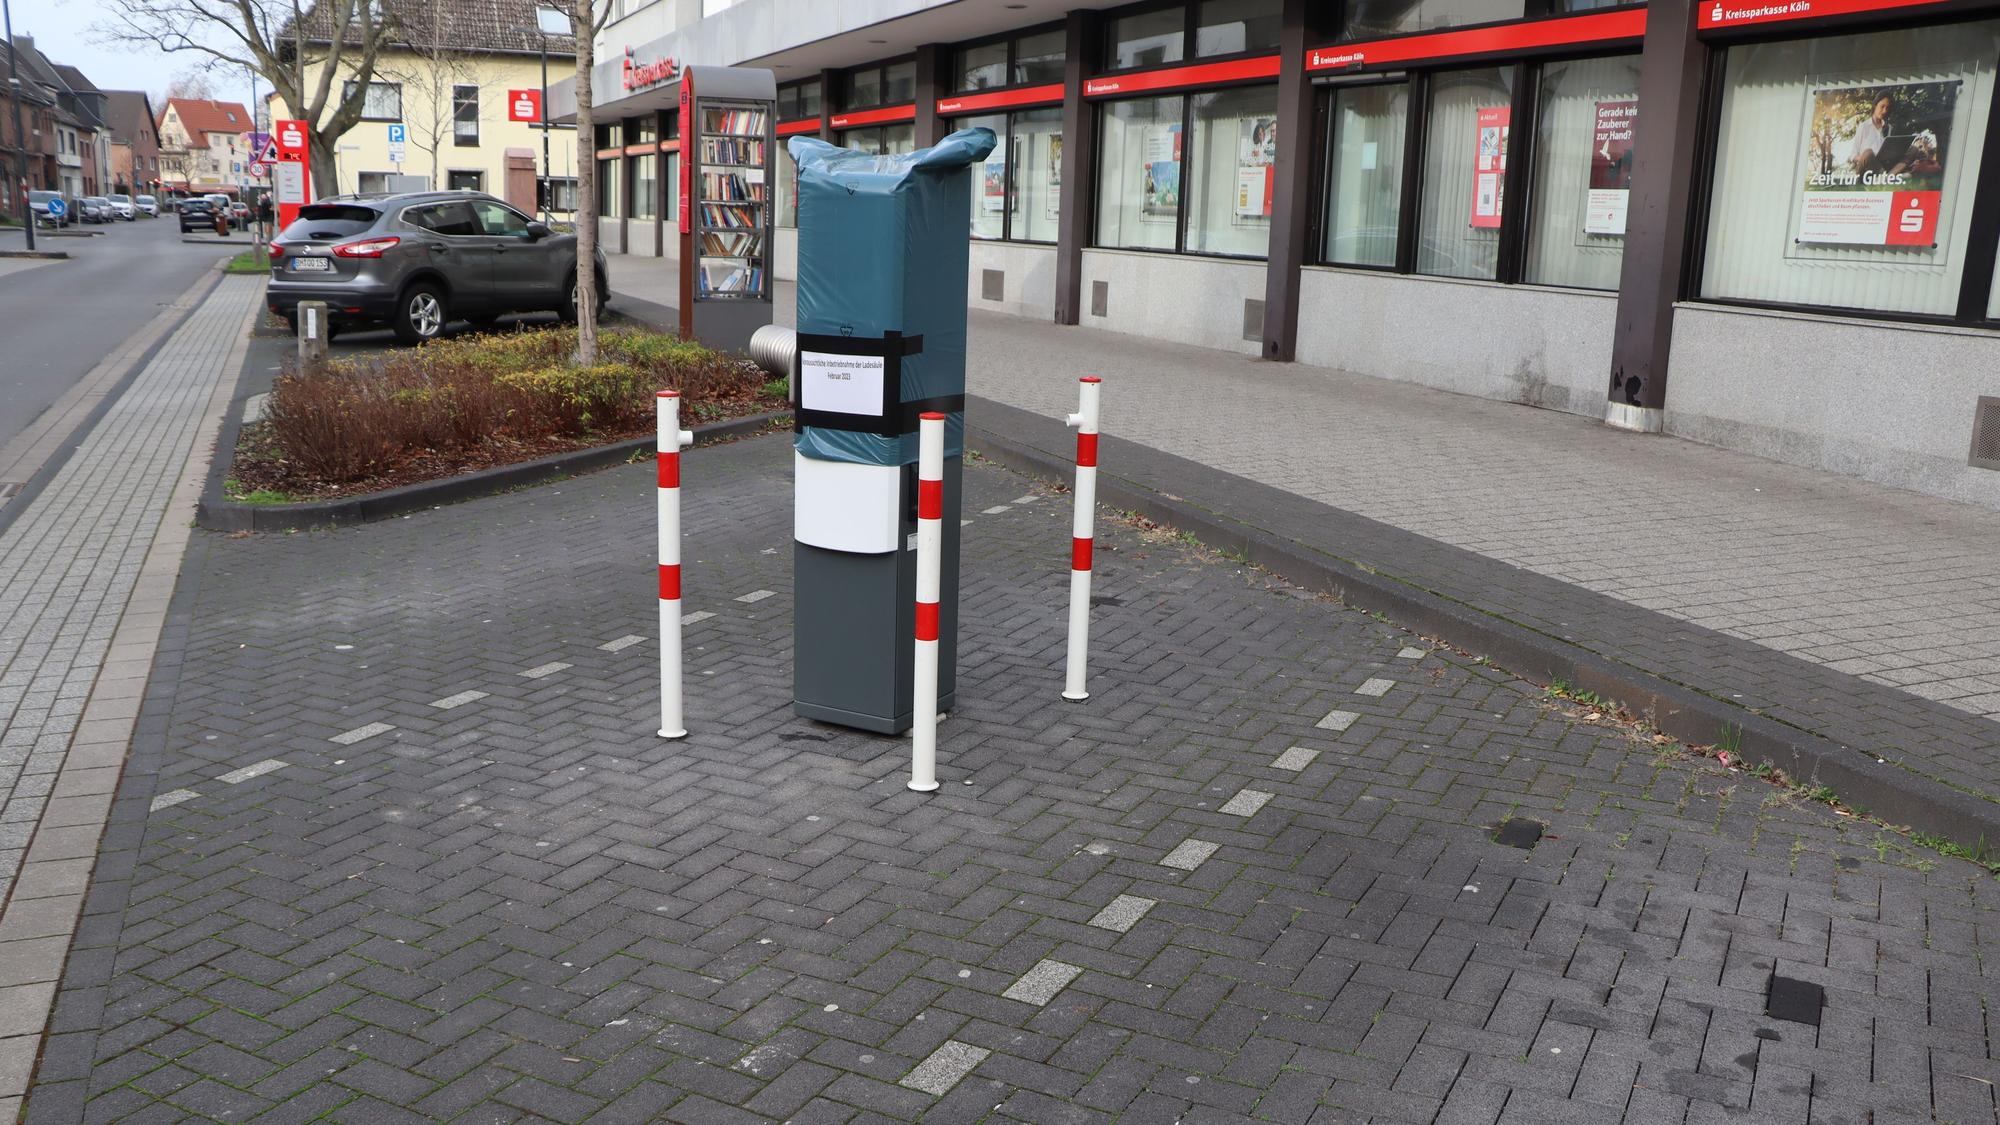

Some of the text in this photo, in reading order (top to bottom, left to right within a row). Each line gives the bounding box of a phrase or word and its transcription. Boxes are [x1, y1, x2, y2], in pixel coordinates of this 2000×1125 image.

[1725, 6, 1788, 20] Kreissparkasse
[1790, 1, 1810, 13] Köln
[1598, 107, 1624, 118] Gerade
[1597, 119, 1630, 129] Zauberer
[1596, 130, 1632, 141] zur Hand?
[252, 165, 263, 174] 30
[1809, 170, 1907, 186] Zeit für Gutes.
[827, 371, 841, 381] Februar
